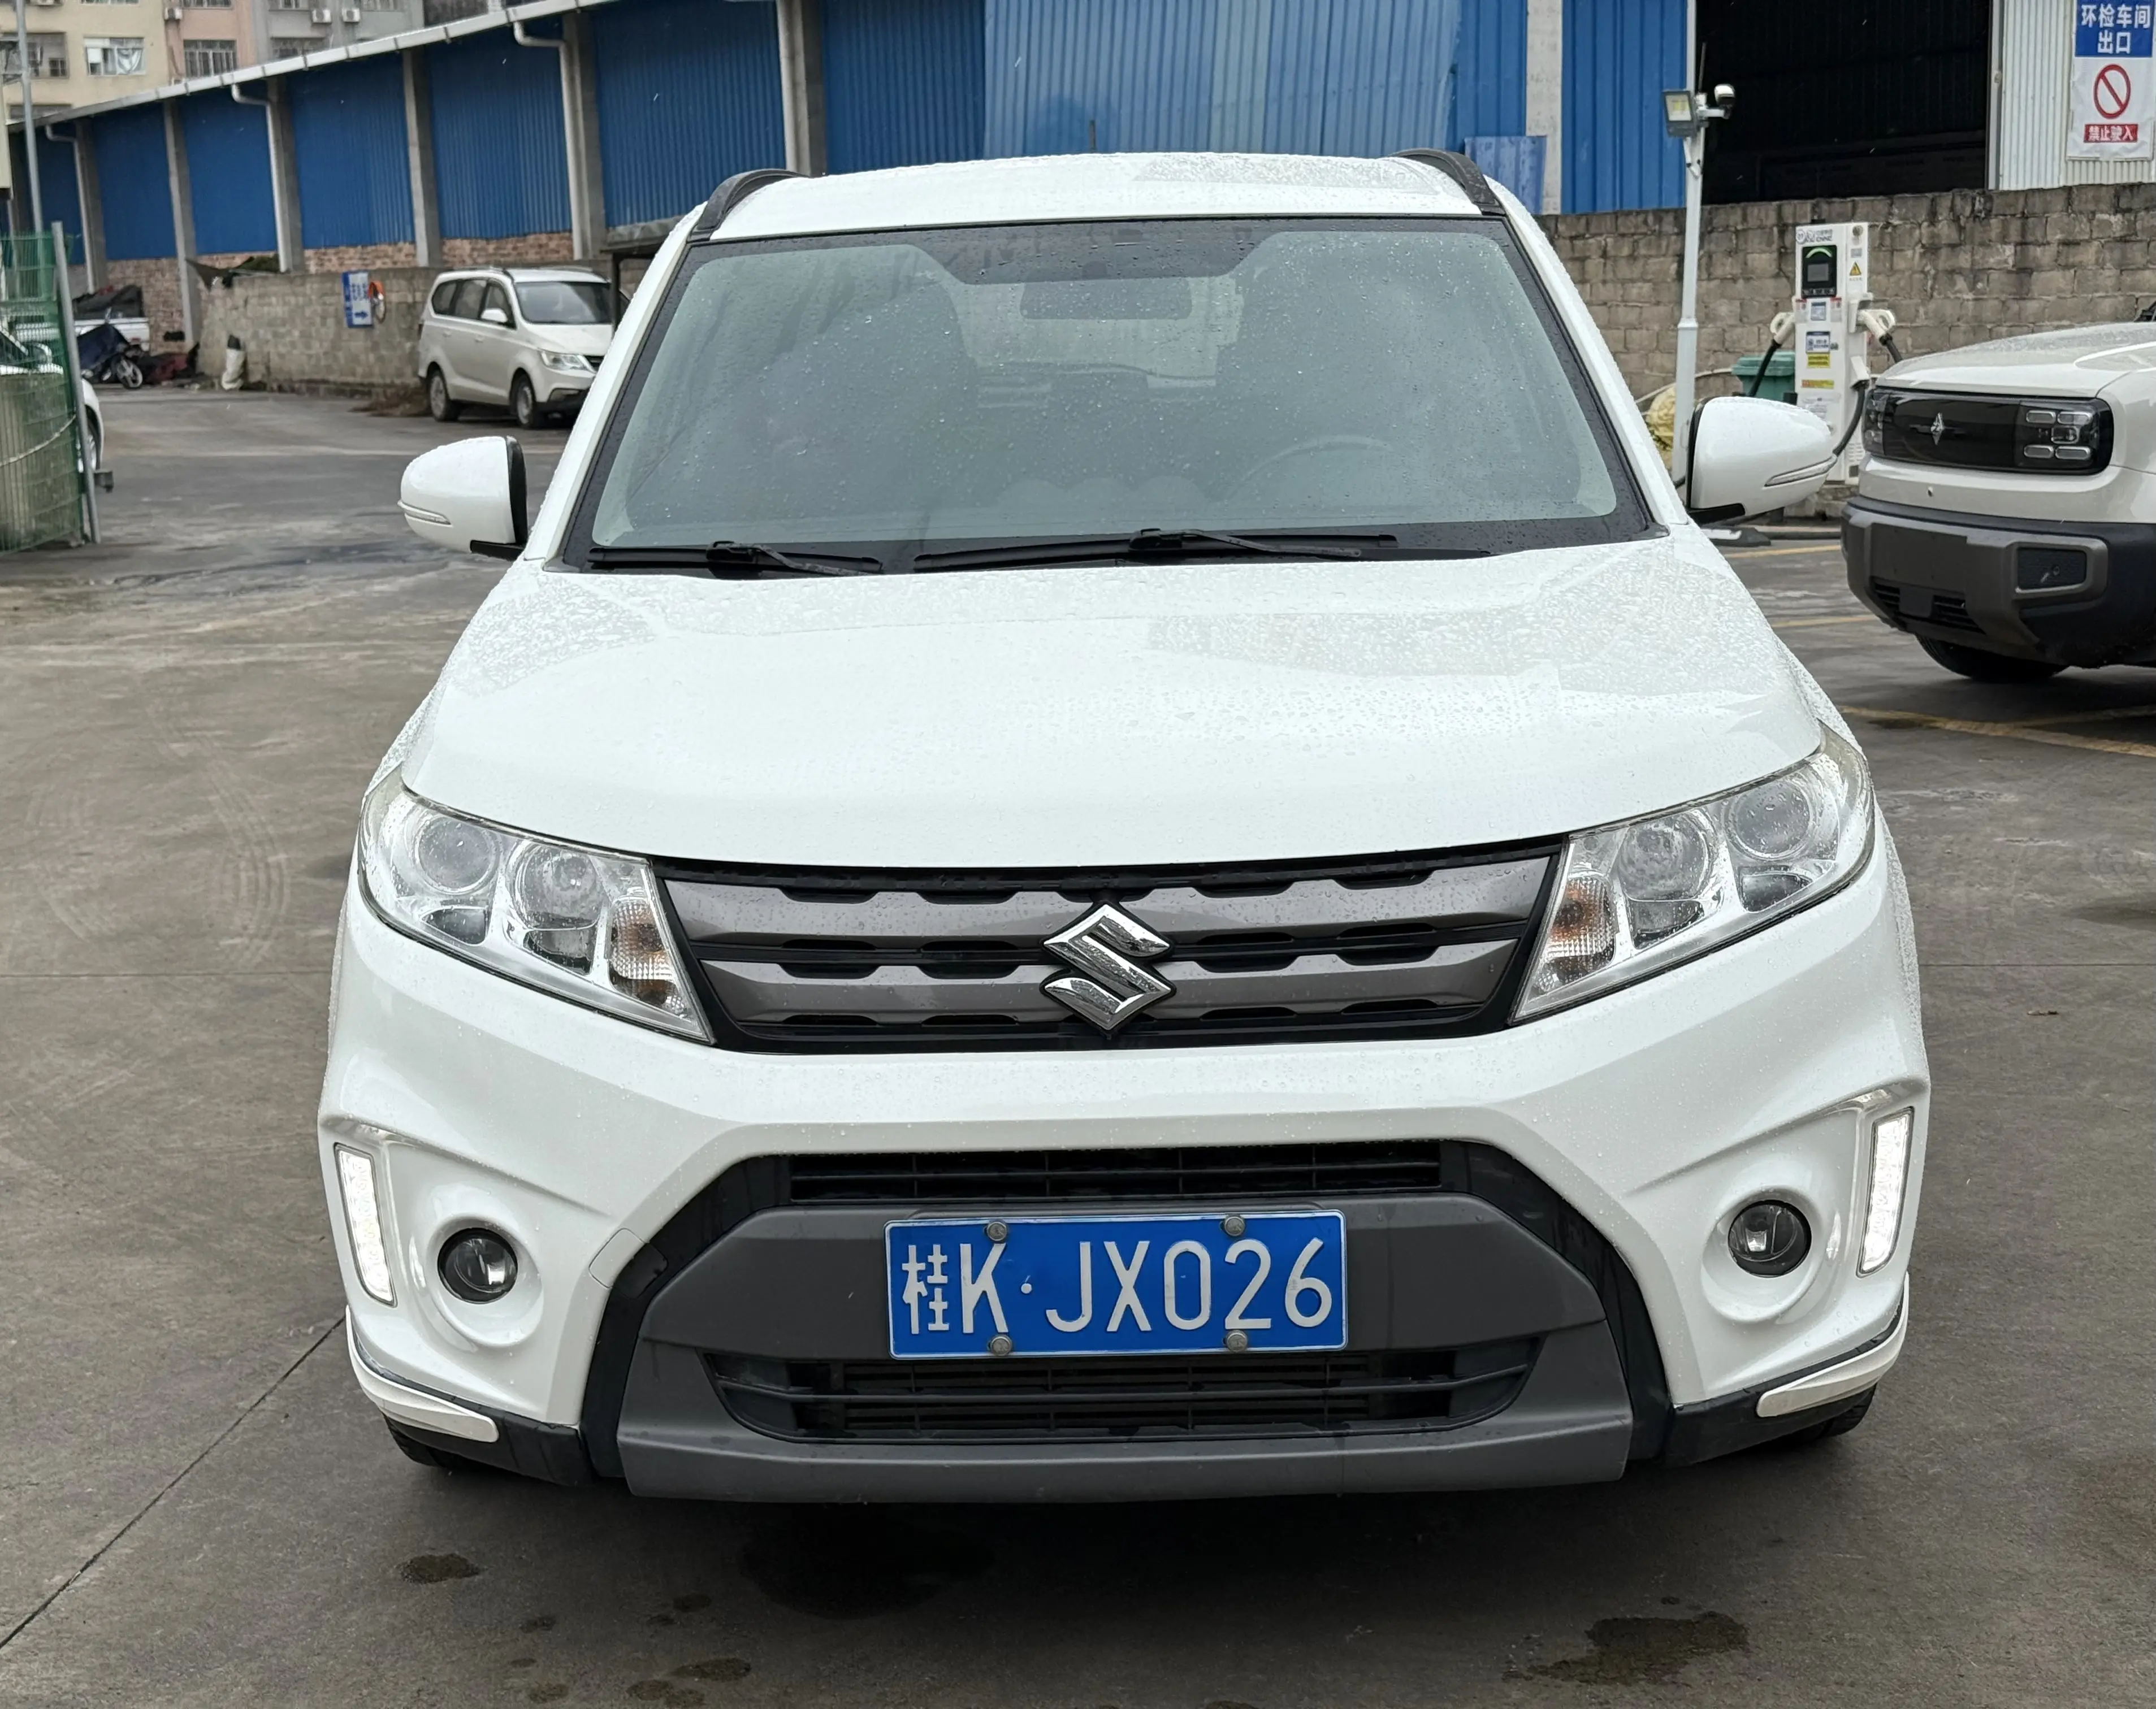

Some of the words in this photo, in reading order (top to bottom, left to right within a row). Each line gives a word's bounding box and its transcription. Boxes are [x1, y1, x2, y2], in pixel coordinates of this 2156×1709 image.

[2081, 4, 2150, 28] 环检车间
[2097, 30, 2131, 54] 出口
